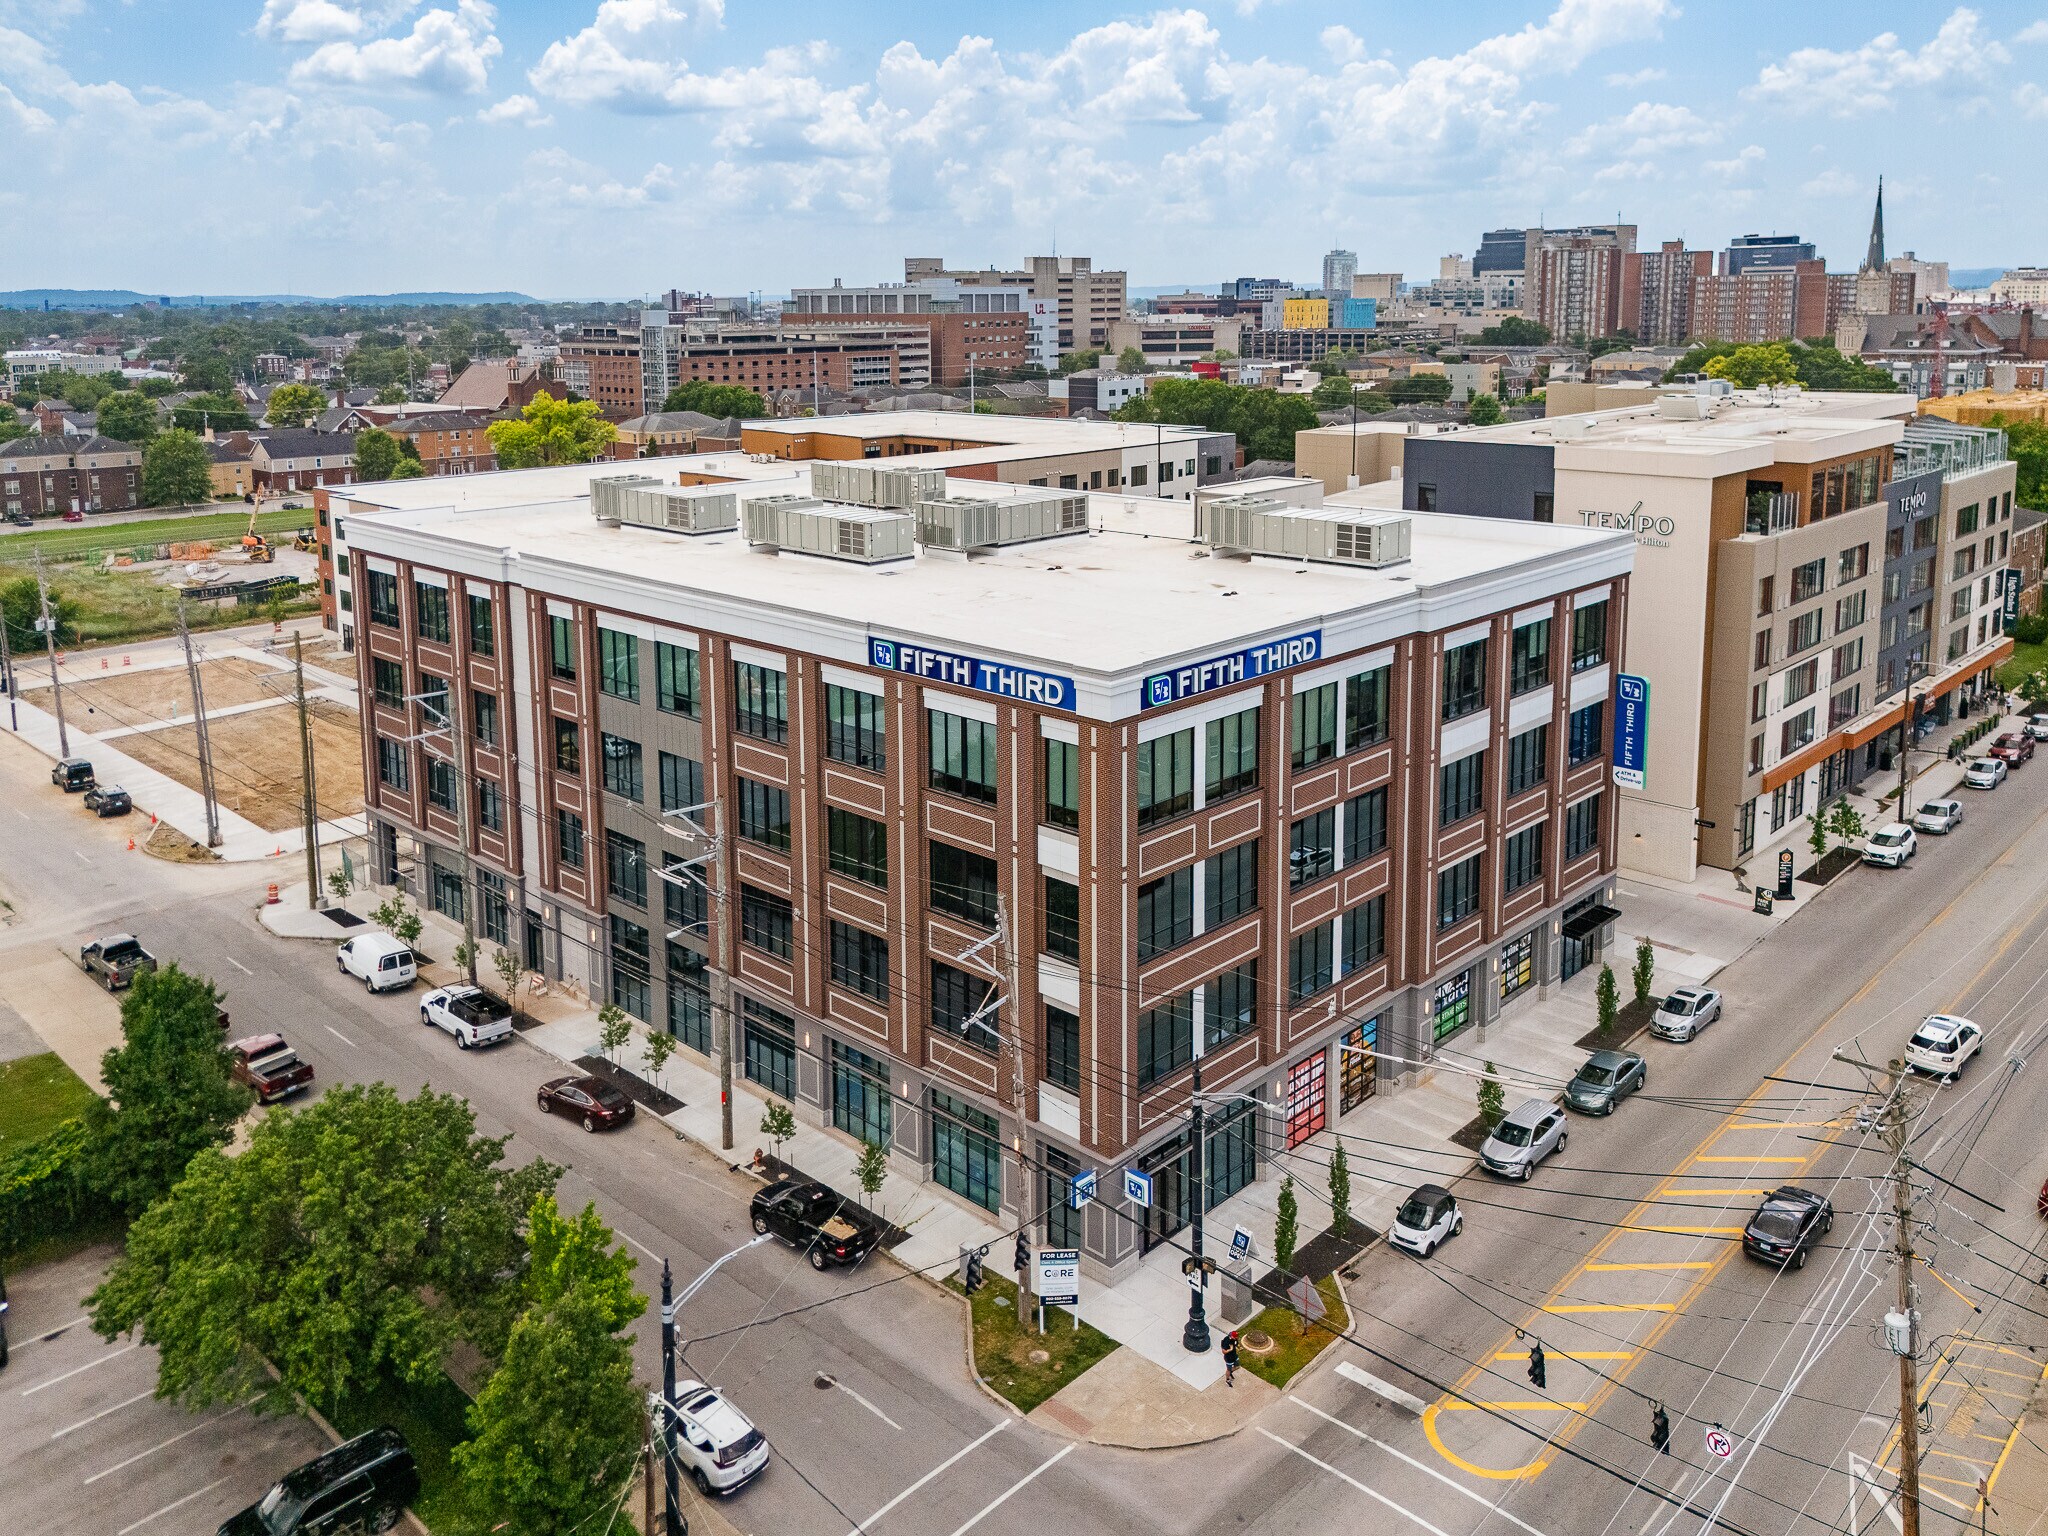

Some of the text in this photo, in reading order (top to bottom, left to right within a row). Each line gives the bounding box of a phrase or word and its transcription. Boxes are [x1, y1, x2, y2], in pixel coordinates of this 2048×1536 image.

[1578, 501, 1675, 536] TEMPO
[1900, 487, 1927, 515] TEMPO
[1641, 536, 1670, 548] Hilton
[900, 647, 972, 686] FIFTH
[980, 664, 1064, 705] THIRD
[1177, 655, 1244, 697] FIFTH
[1251, 636, 1316, 674] THIRD
[1624, 702, 1635, 766] FIFTH THIRD
